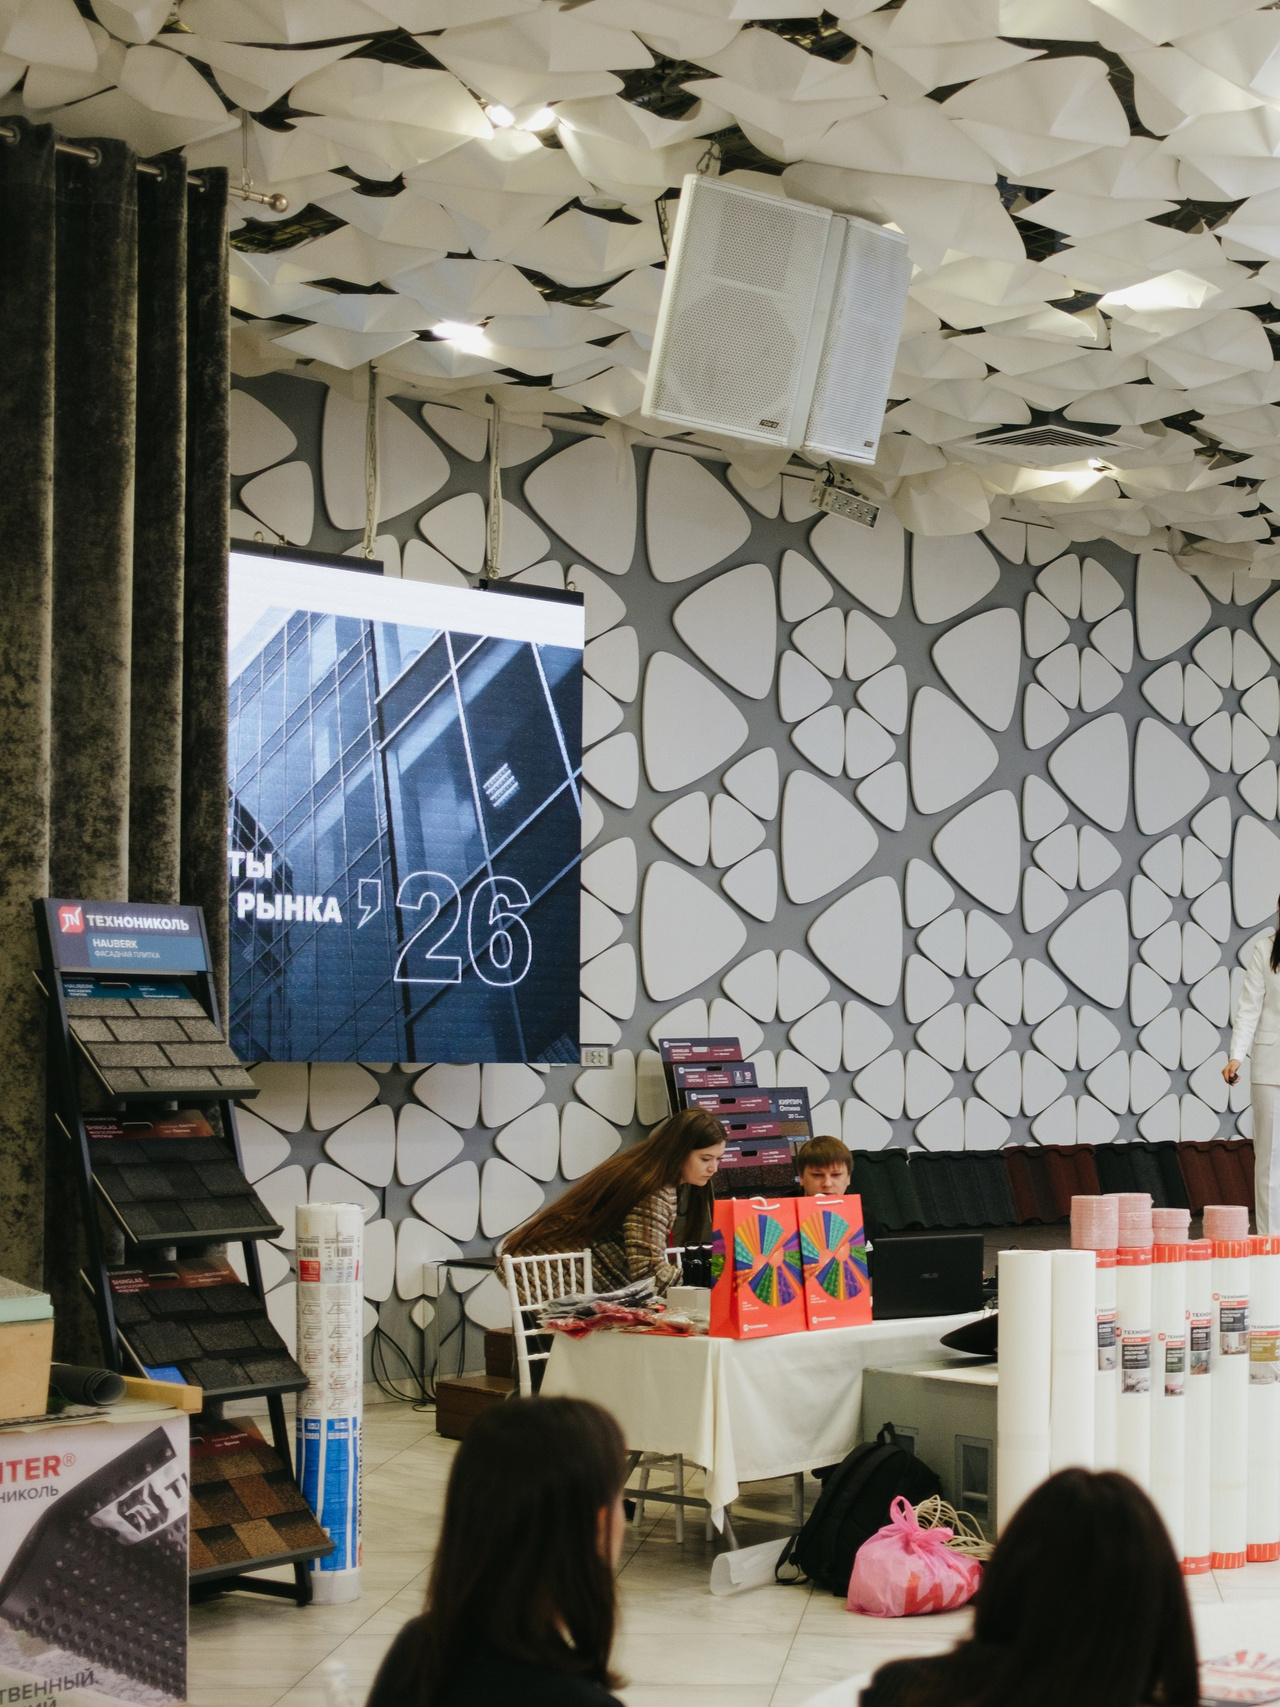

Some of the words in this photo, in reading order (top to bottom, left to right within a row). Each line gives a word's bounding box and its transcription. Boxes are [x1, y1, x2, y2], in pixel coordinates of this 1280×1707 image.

[237, 893, 343, 923] РЫНКА
[86, 914, 190, 932] ТЕХНОНИКОЛЬ
[92, 938, 138, 950] HAUBERK
[94, 950, 134, 960] ФАСАДНАЯ
[135, 951, 161, 960] ПЛИТКА
